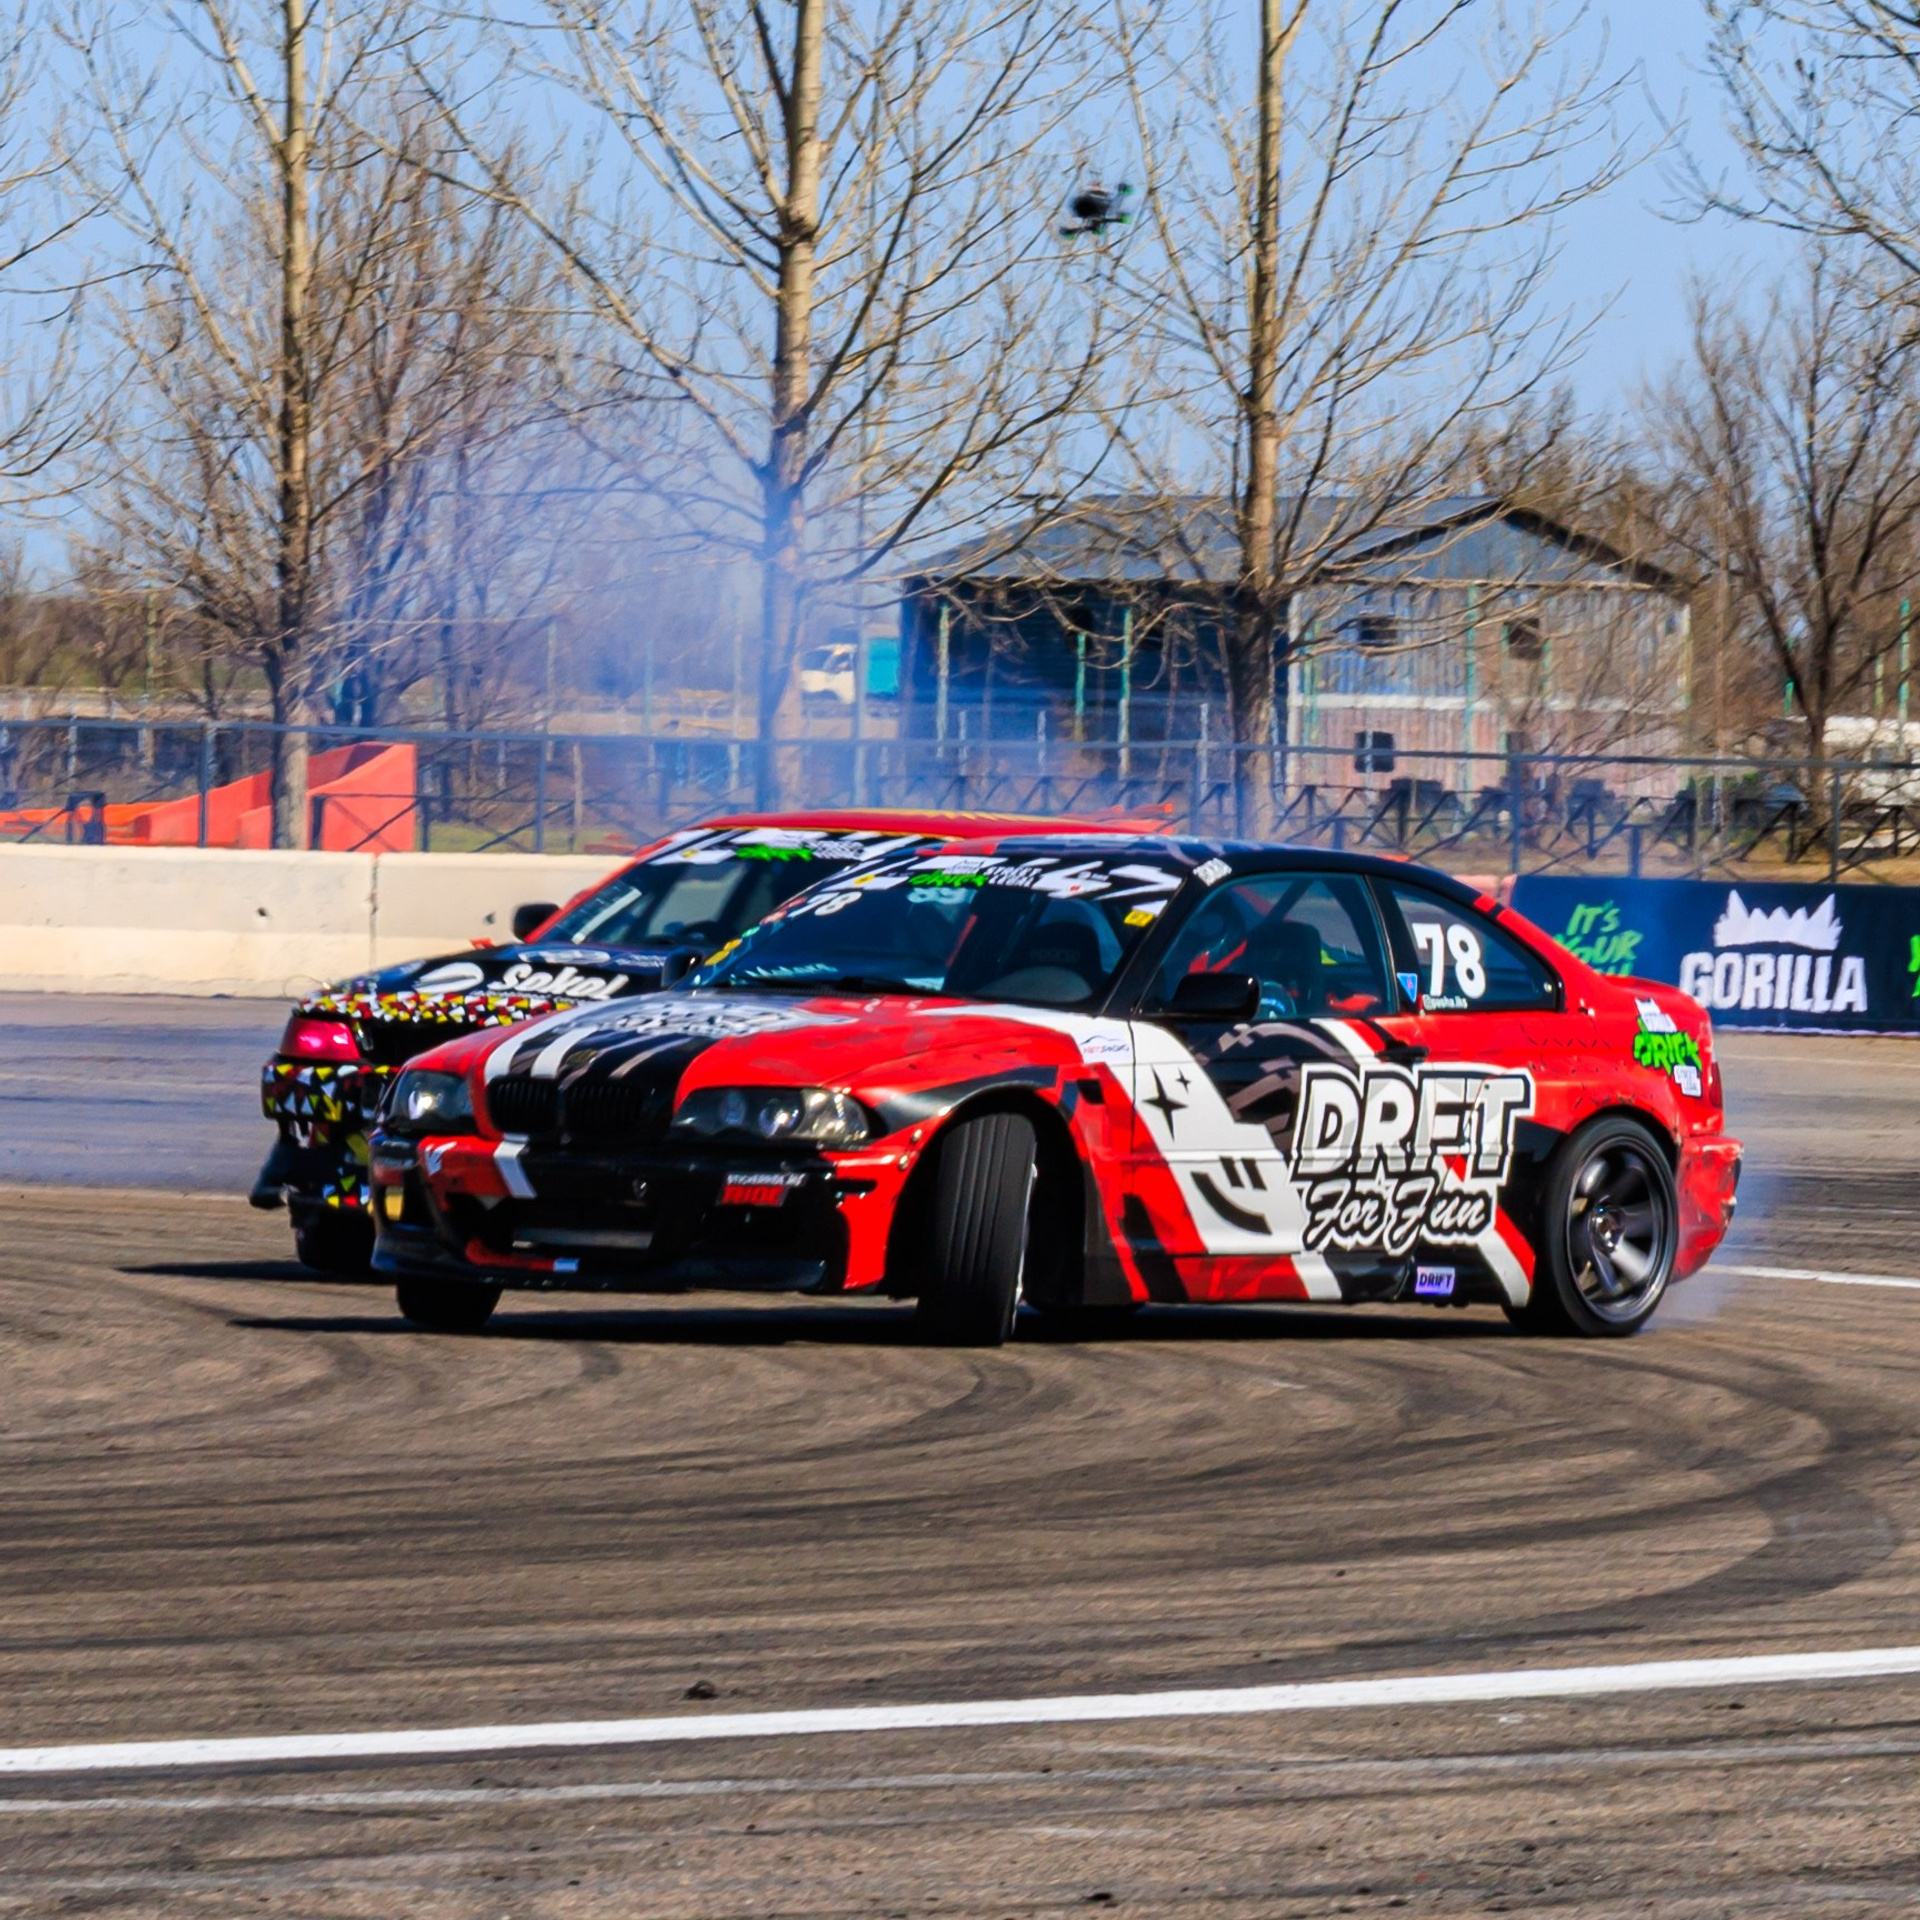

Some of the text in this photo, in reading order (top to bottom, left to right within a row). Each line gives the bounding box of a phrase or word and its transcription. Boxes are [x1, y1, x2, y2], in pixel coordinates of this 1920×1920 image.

[788, 891, 863, 918] 78
[1411, 922, 1487, 999] 78
[1679, 951, 1868, 1013] GORILLA
[1418, 1272, 1454, 1290] DRIFT
